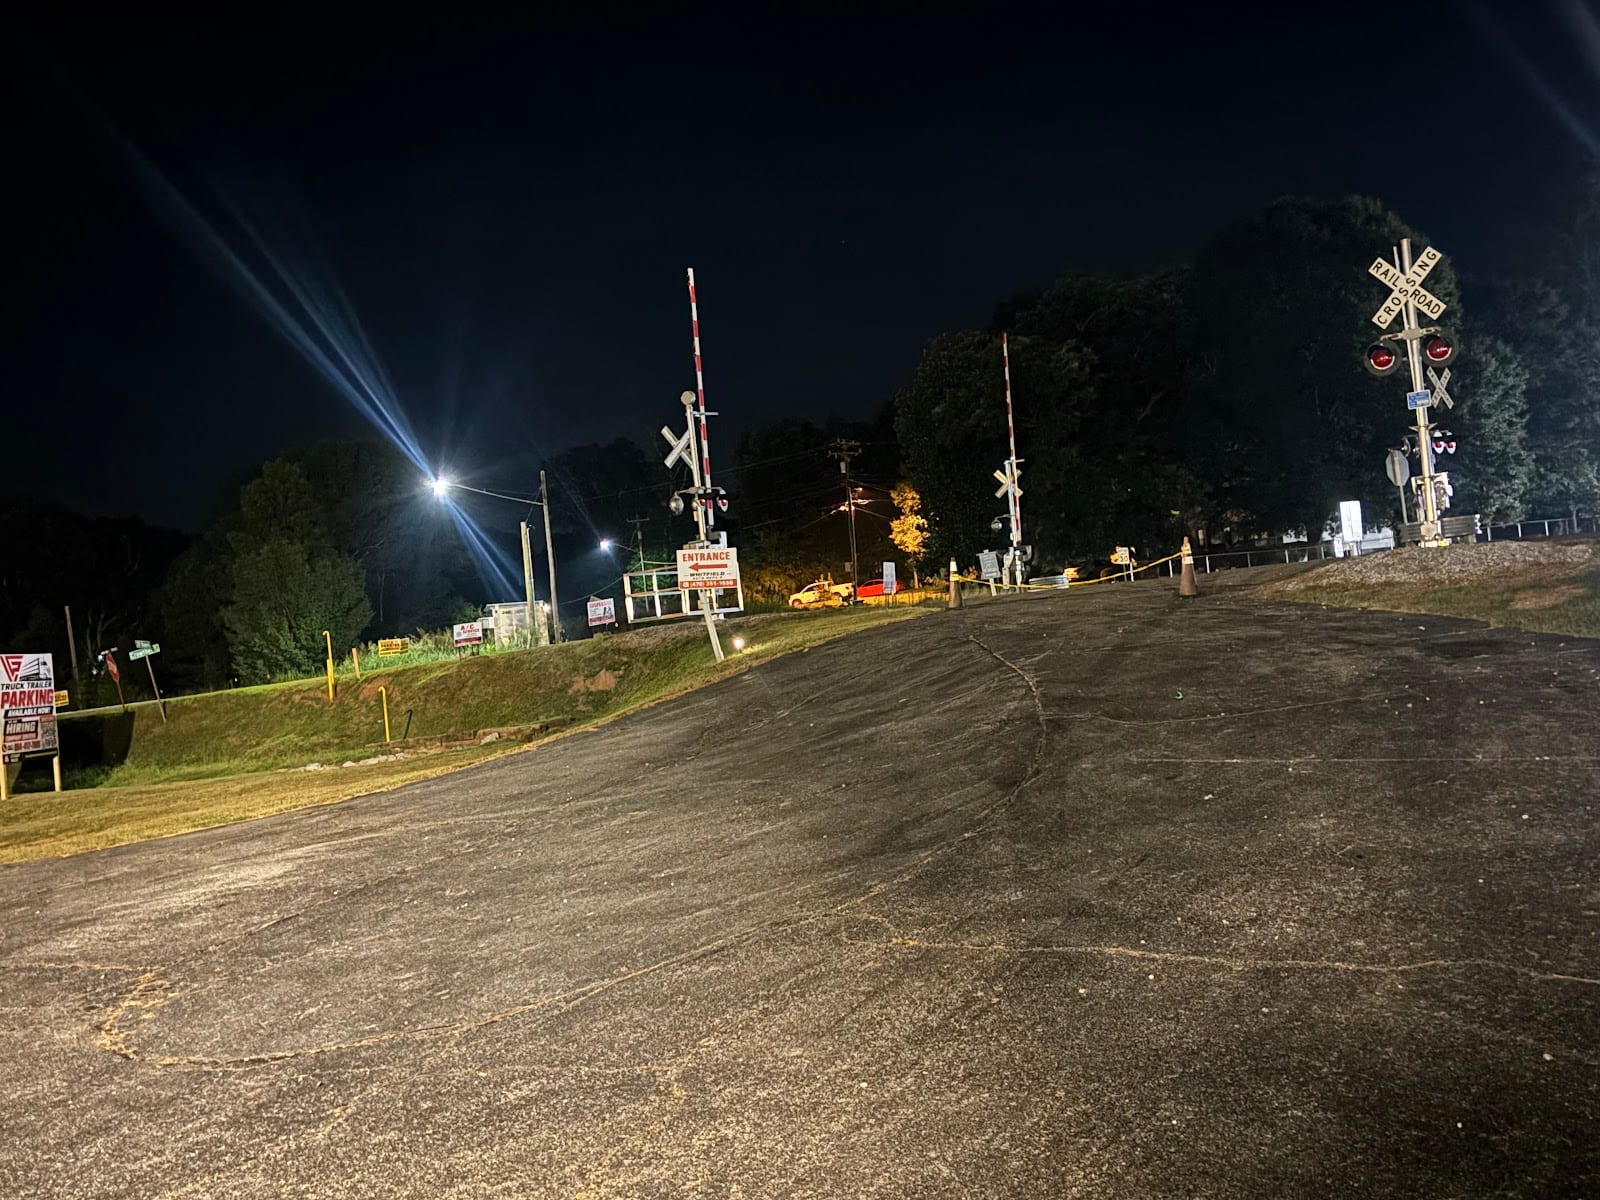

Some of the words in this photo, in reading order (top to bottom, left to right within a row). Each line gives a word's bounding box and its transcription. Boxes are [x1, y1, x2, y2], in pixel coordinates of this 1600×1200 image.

[1373, 261, 1400, 288] RAIL
[1410, 288, 1441, 316] ROAD
[1376, 250, 1437, 325] CROSSING
[682, 551, 731, 562] ENTRANCE
[1, 682, 25, 691] TRUCK
[27, 681, 52, 689] TRAILER
[1, 688, 54, 709] PARKING
[7, 708, 38, 717] AVAILABLE
[6, 721, 36, 735] HIRING
